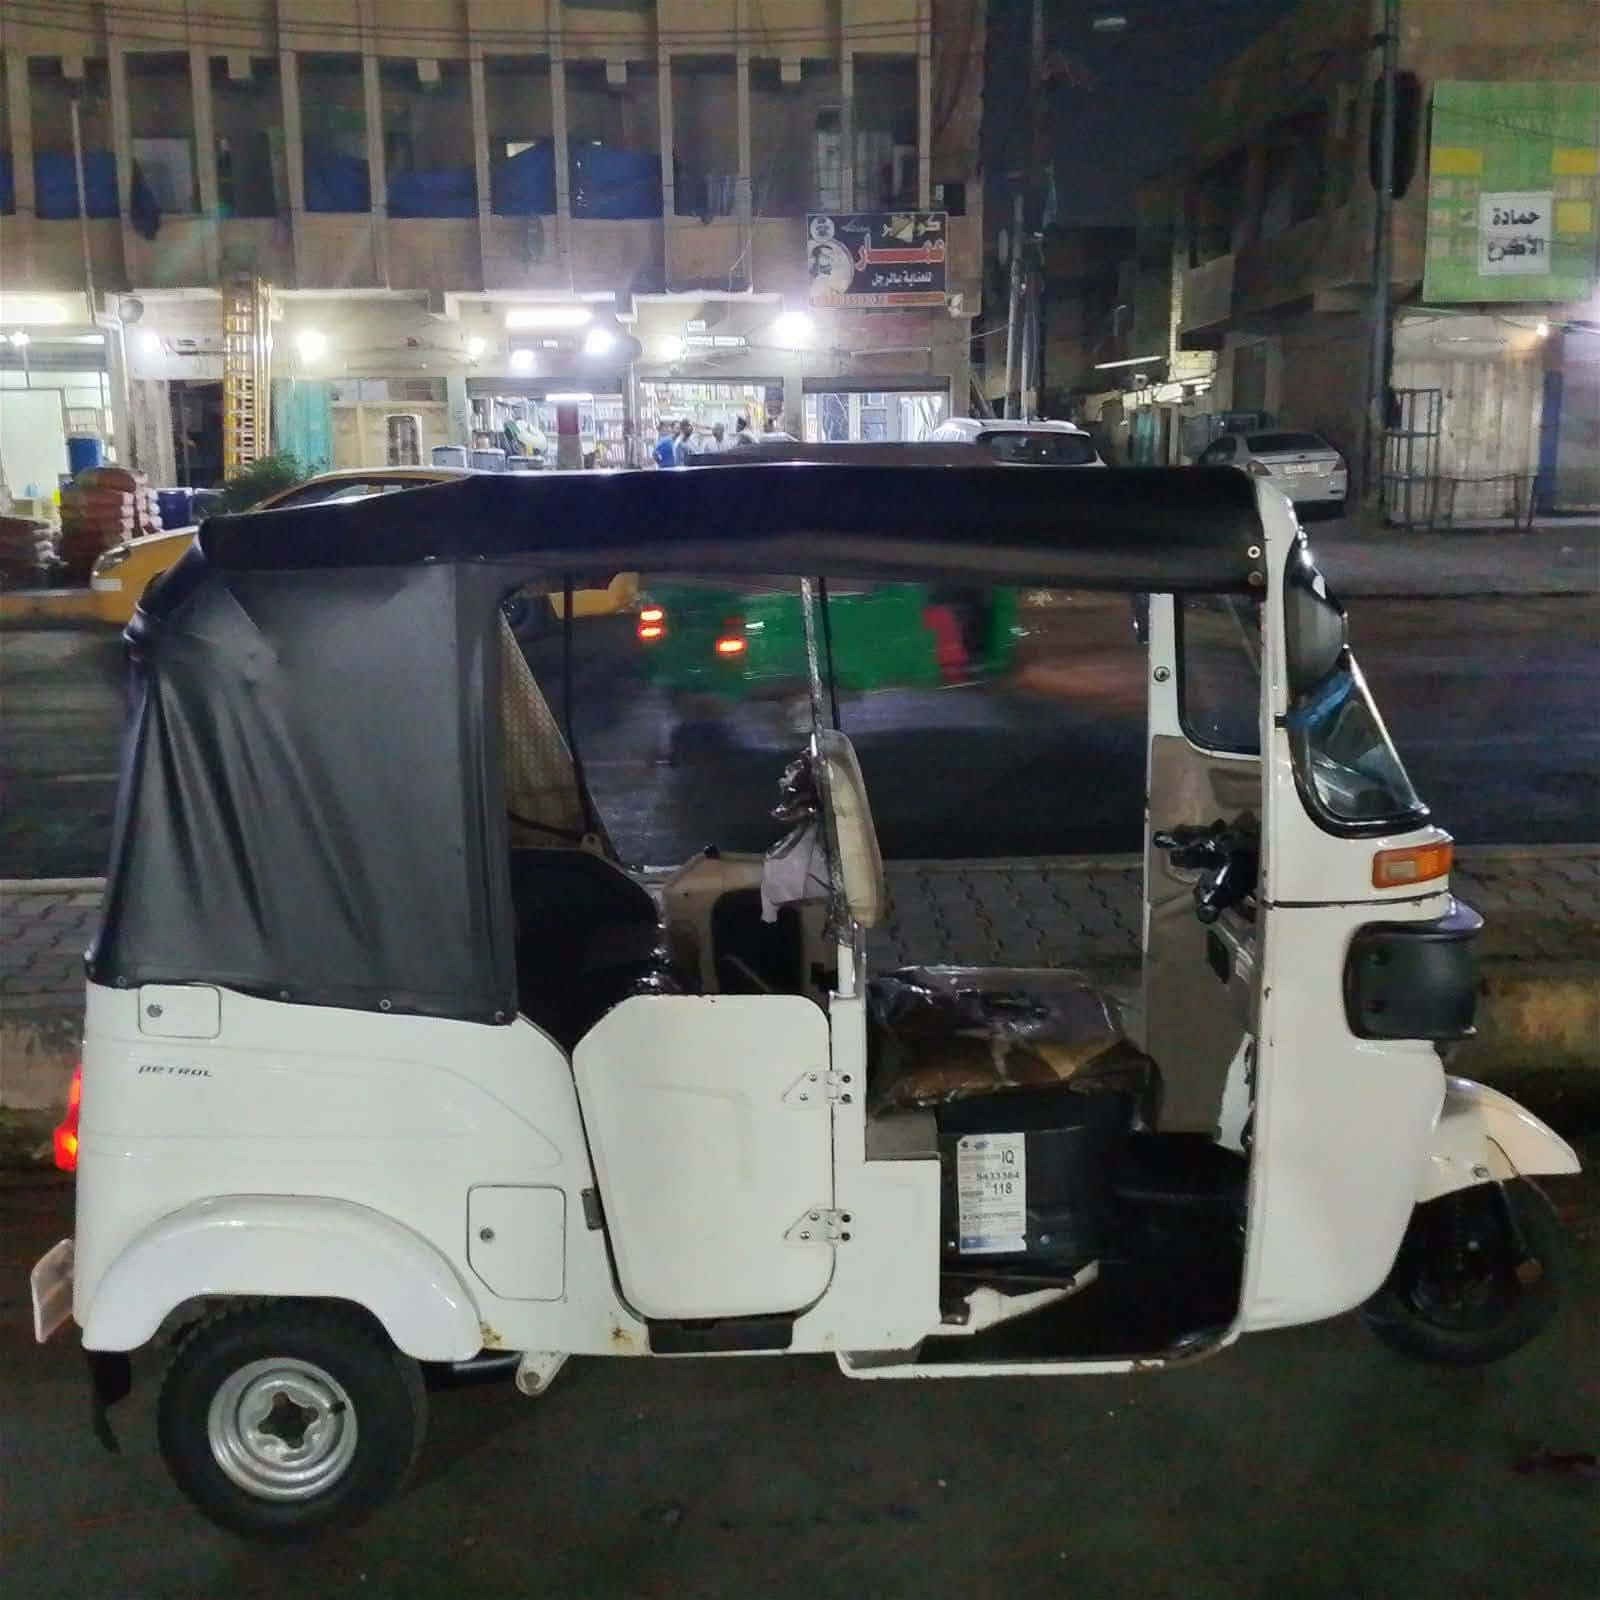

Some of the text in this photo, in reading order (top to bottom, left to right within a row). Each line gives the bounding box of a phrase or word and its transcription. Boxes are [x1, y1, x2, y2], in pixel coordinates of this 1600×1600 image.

[1492, 208, 1540, 226] حمادة
[1001, 1150, 1015, 1164] IQ
[993, 1182, 1013, 1195] 118
